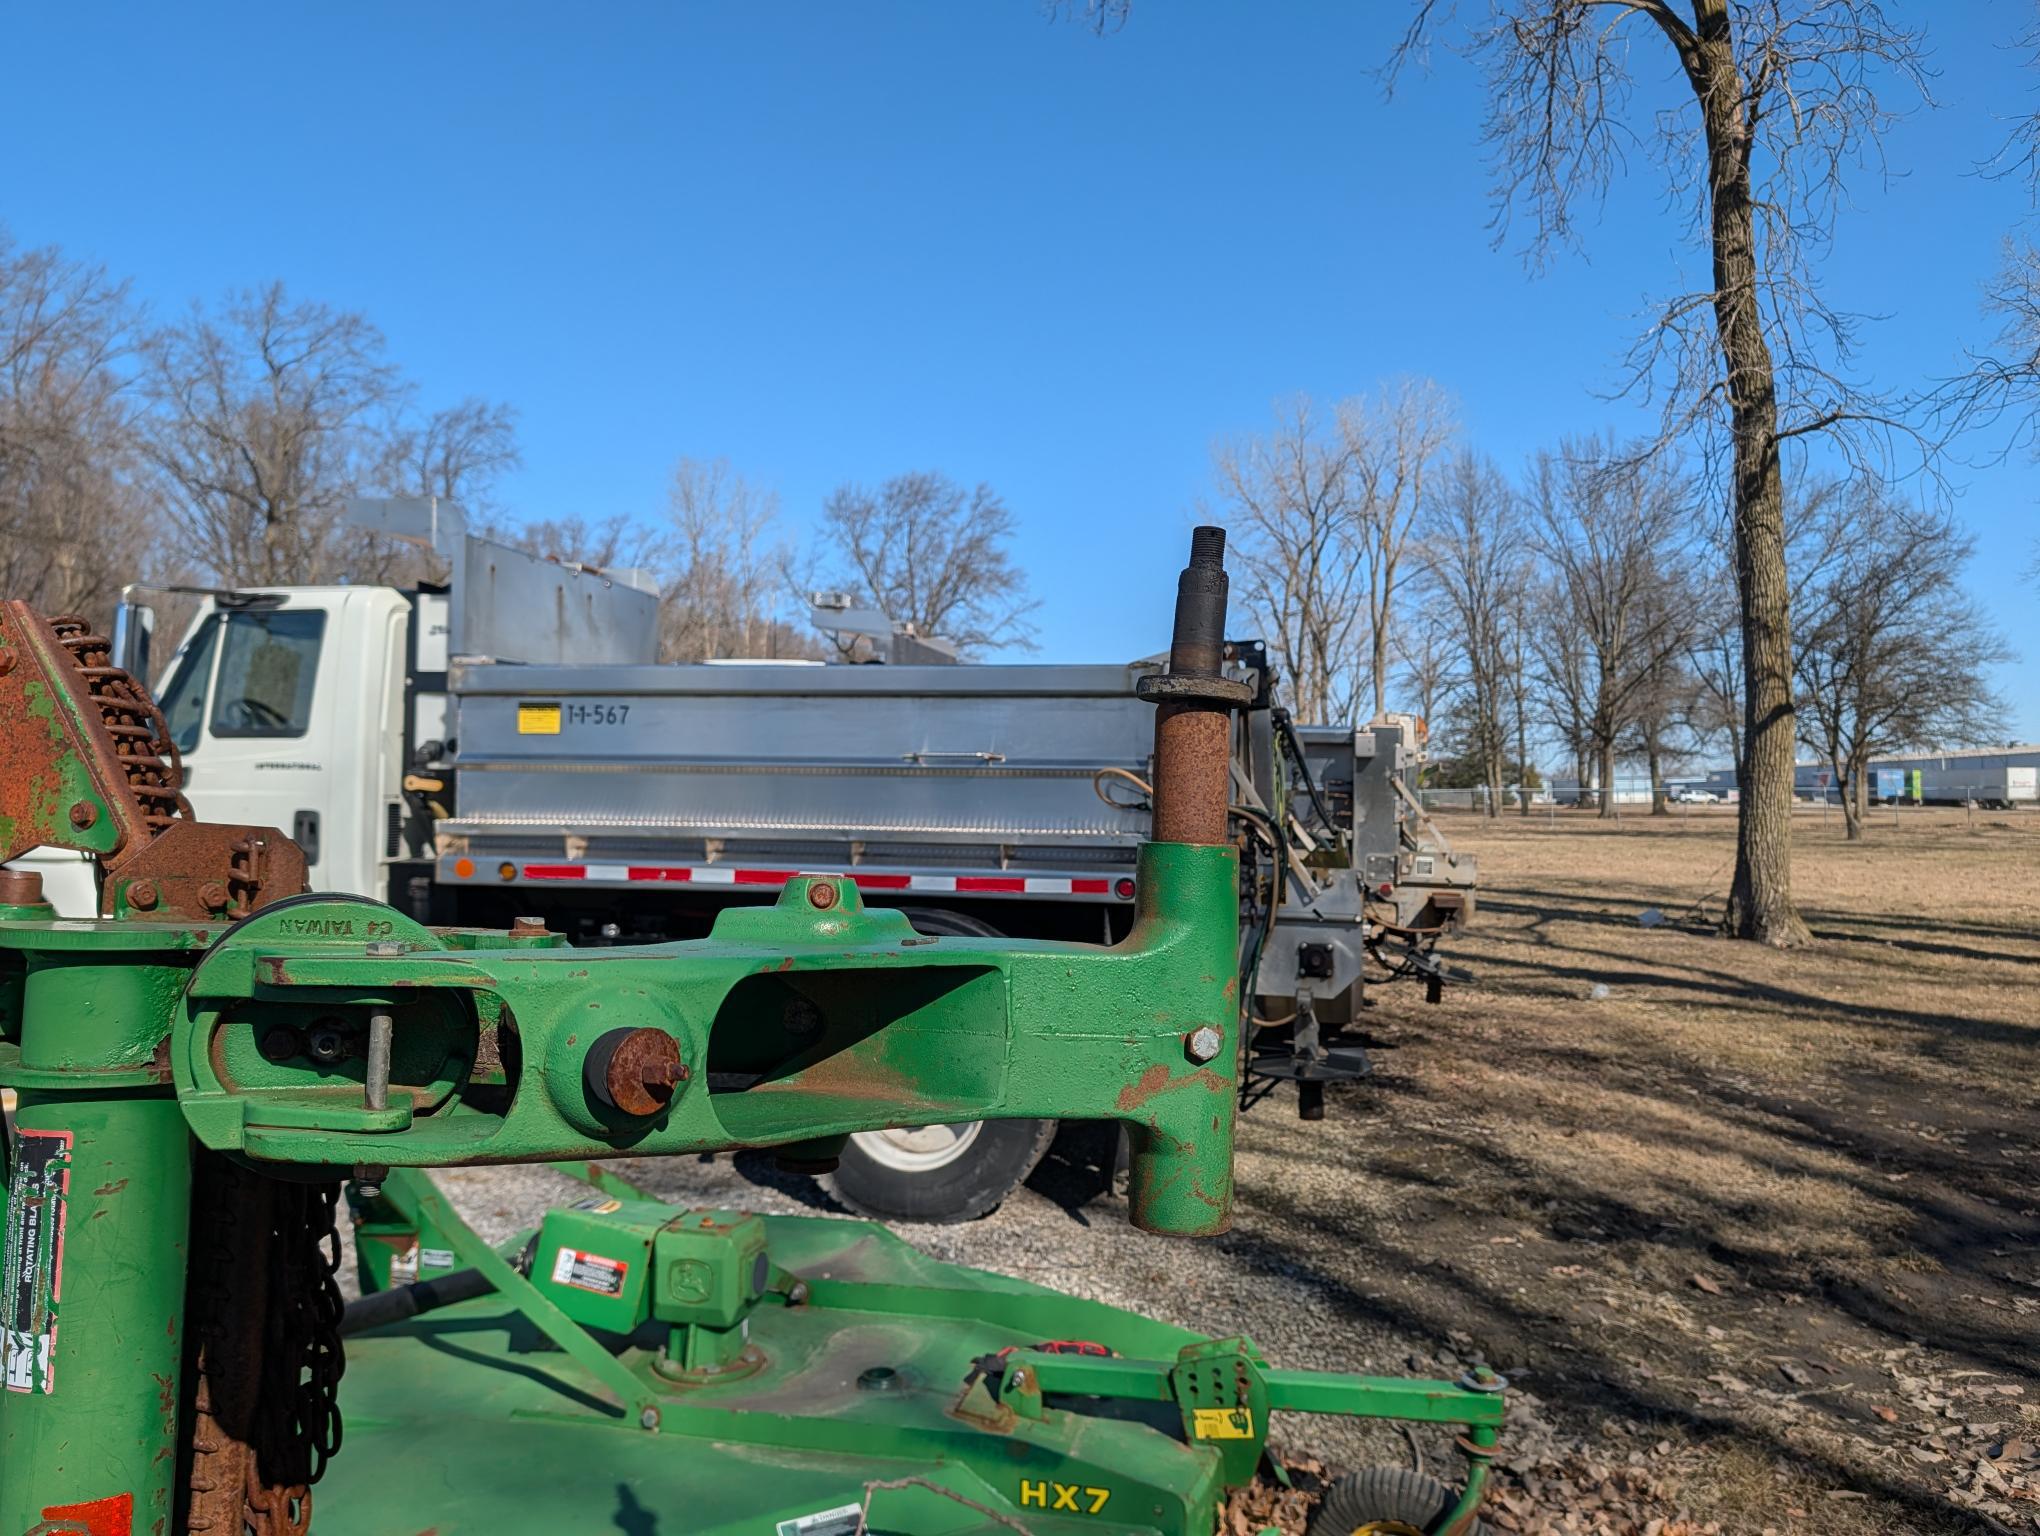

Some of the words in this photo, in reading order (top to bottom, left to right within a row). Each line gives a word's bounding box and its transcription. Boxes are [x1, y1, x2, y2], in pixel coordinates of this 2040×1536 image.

[279, 919, 355, 936] TAIWAN
[367, 920, 393, 936] C4
[29, 1183, 40, 1226] BLAS
[25, 1228, 36, 1283] ROTATING
[1020, 1479, 1111, 1515] HX7
